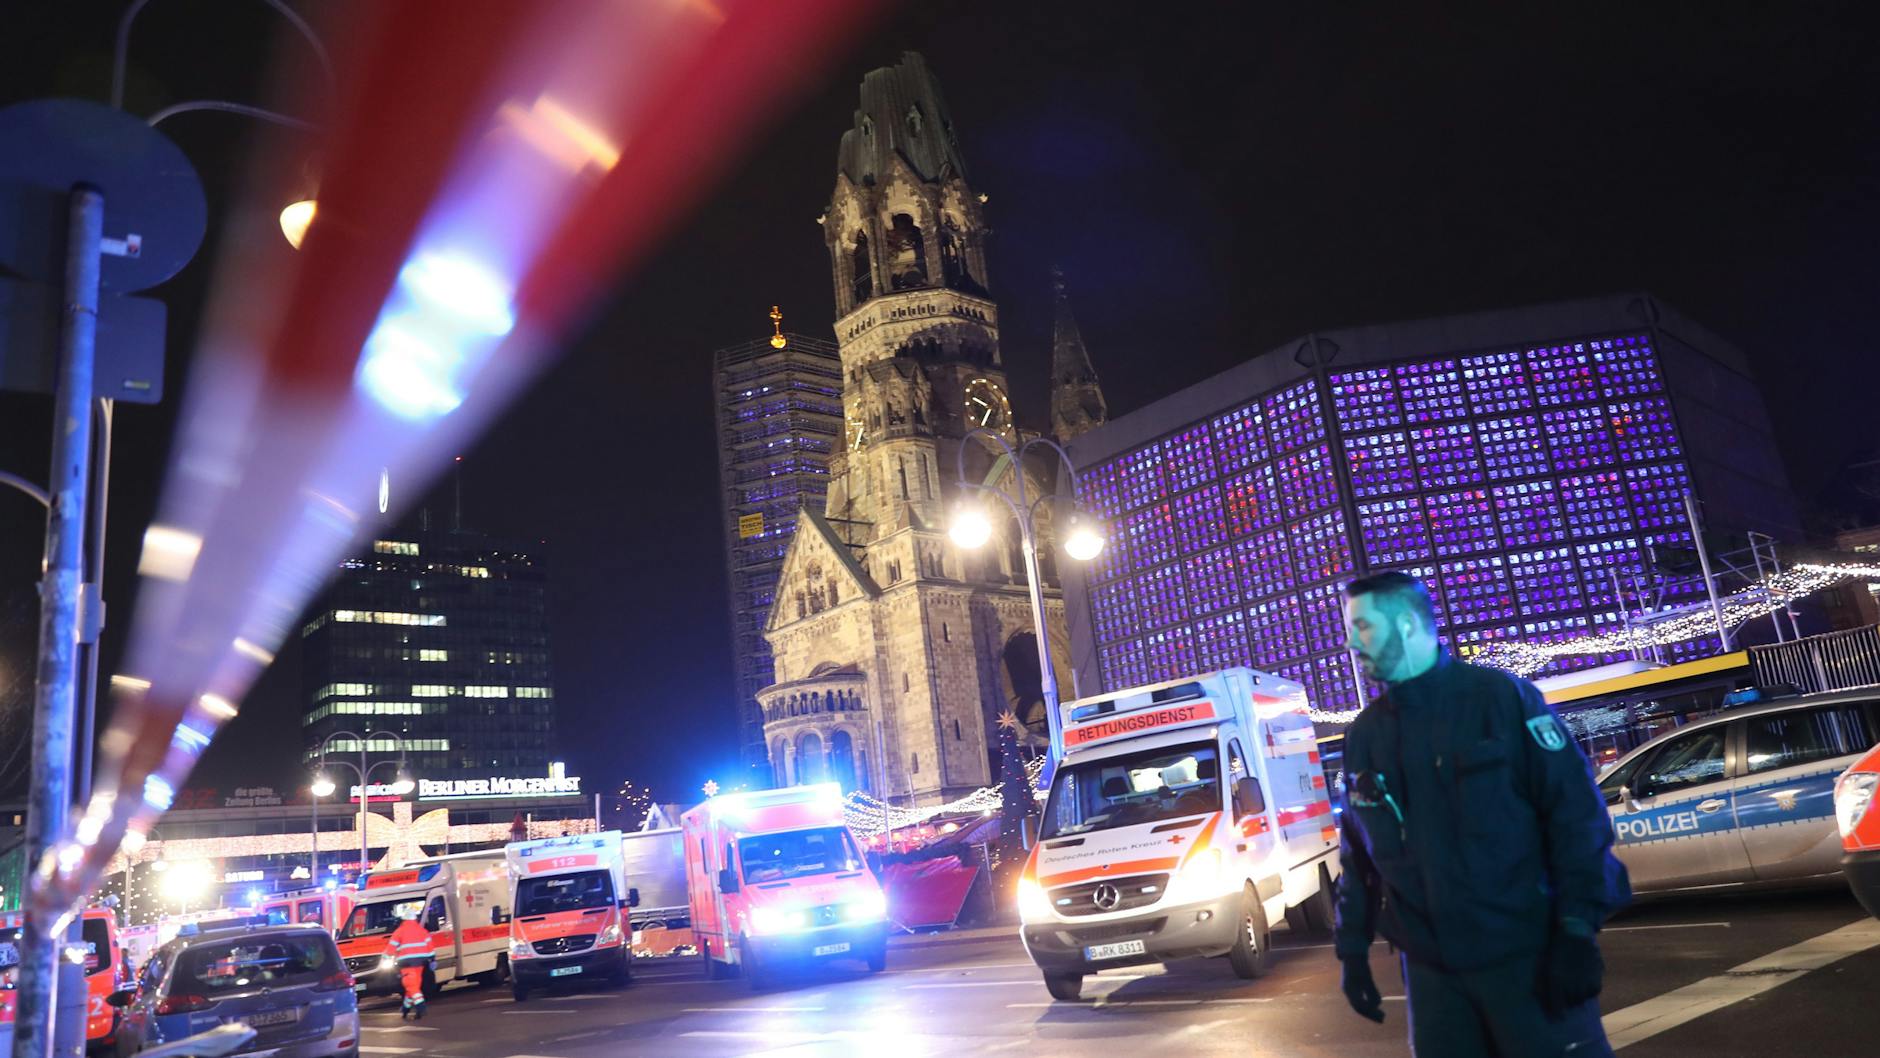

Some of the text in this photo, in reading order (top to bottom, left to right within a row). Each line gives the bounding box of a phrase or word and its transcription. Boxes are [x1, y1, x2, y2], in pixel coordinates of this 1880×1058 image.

[1078, 707, 1196, 741] RETTUNGSDIENST
[419, 778, 490, 797] BERLINER
[1616, 811, 1699, 840] POLIZEI
[551, 857, 576, 868] 112
[1044, 840, 1162, 864] Deutsches Rotes Kreuz
[1118, 942, 1143, 954] 8311
